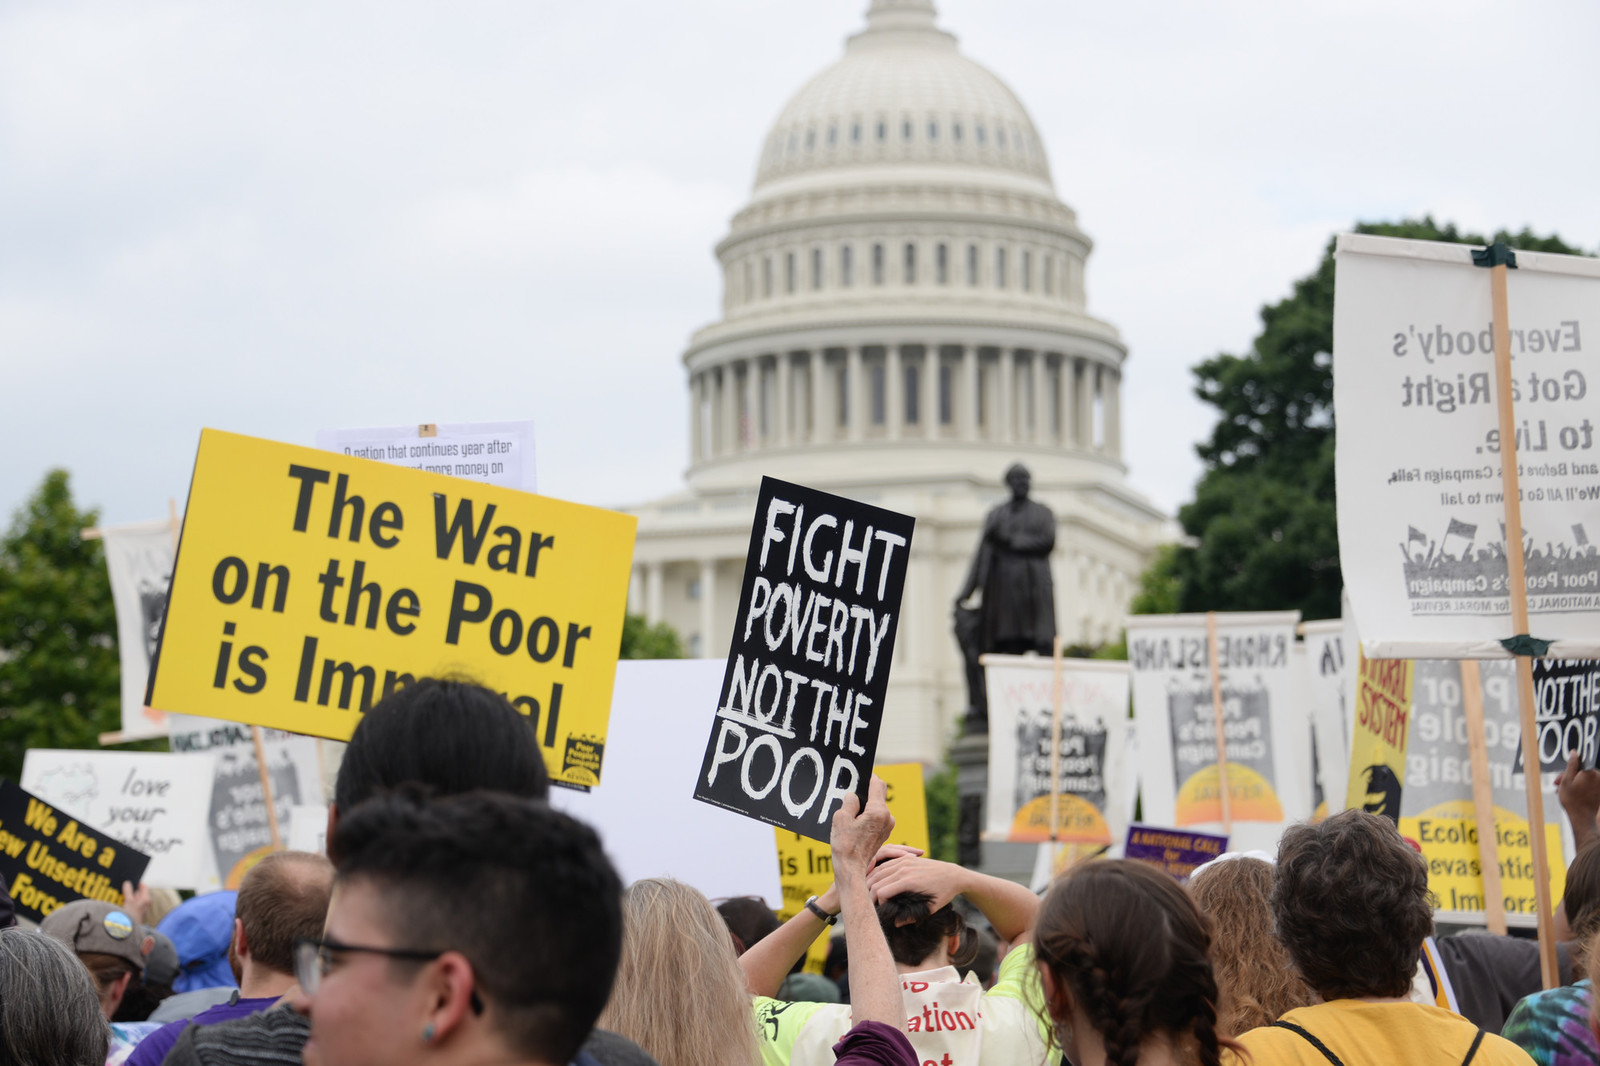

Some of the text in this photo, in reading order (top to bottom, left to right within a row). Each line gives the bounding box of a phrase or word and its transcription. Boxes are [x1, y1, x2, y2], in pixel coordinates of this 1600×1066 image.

[354, 446, 385, 460] nation
[387, 445, 408, 459] that
[410, 442, 459, 458] continues
[461, 442, 485, 458] year
[487, 440, 512, 454] after
[455, 462, 488, 477] money
[491, 461, 503, 474] on
[288, 463, 554, 578] The War
[760, 497, 906, 601] FIGHT
[212, 556, 592, 669] on the Poor
[744, 576, 891, 685] POVERTY
[212, 621, 269, 694] is
[722, 653, 874, 757] NOT THE
[1359, 682, 1406, 753] SYSTEM
[1569, 672, 1600, 716] THE
[121, 766, 170, 796] love
[0, 829, 27, 859] ew
[24, 797, 116, 869] We Are a
[101, 806, 167, 828] your
[1419, 820, 1530, 847] Ecoloica
